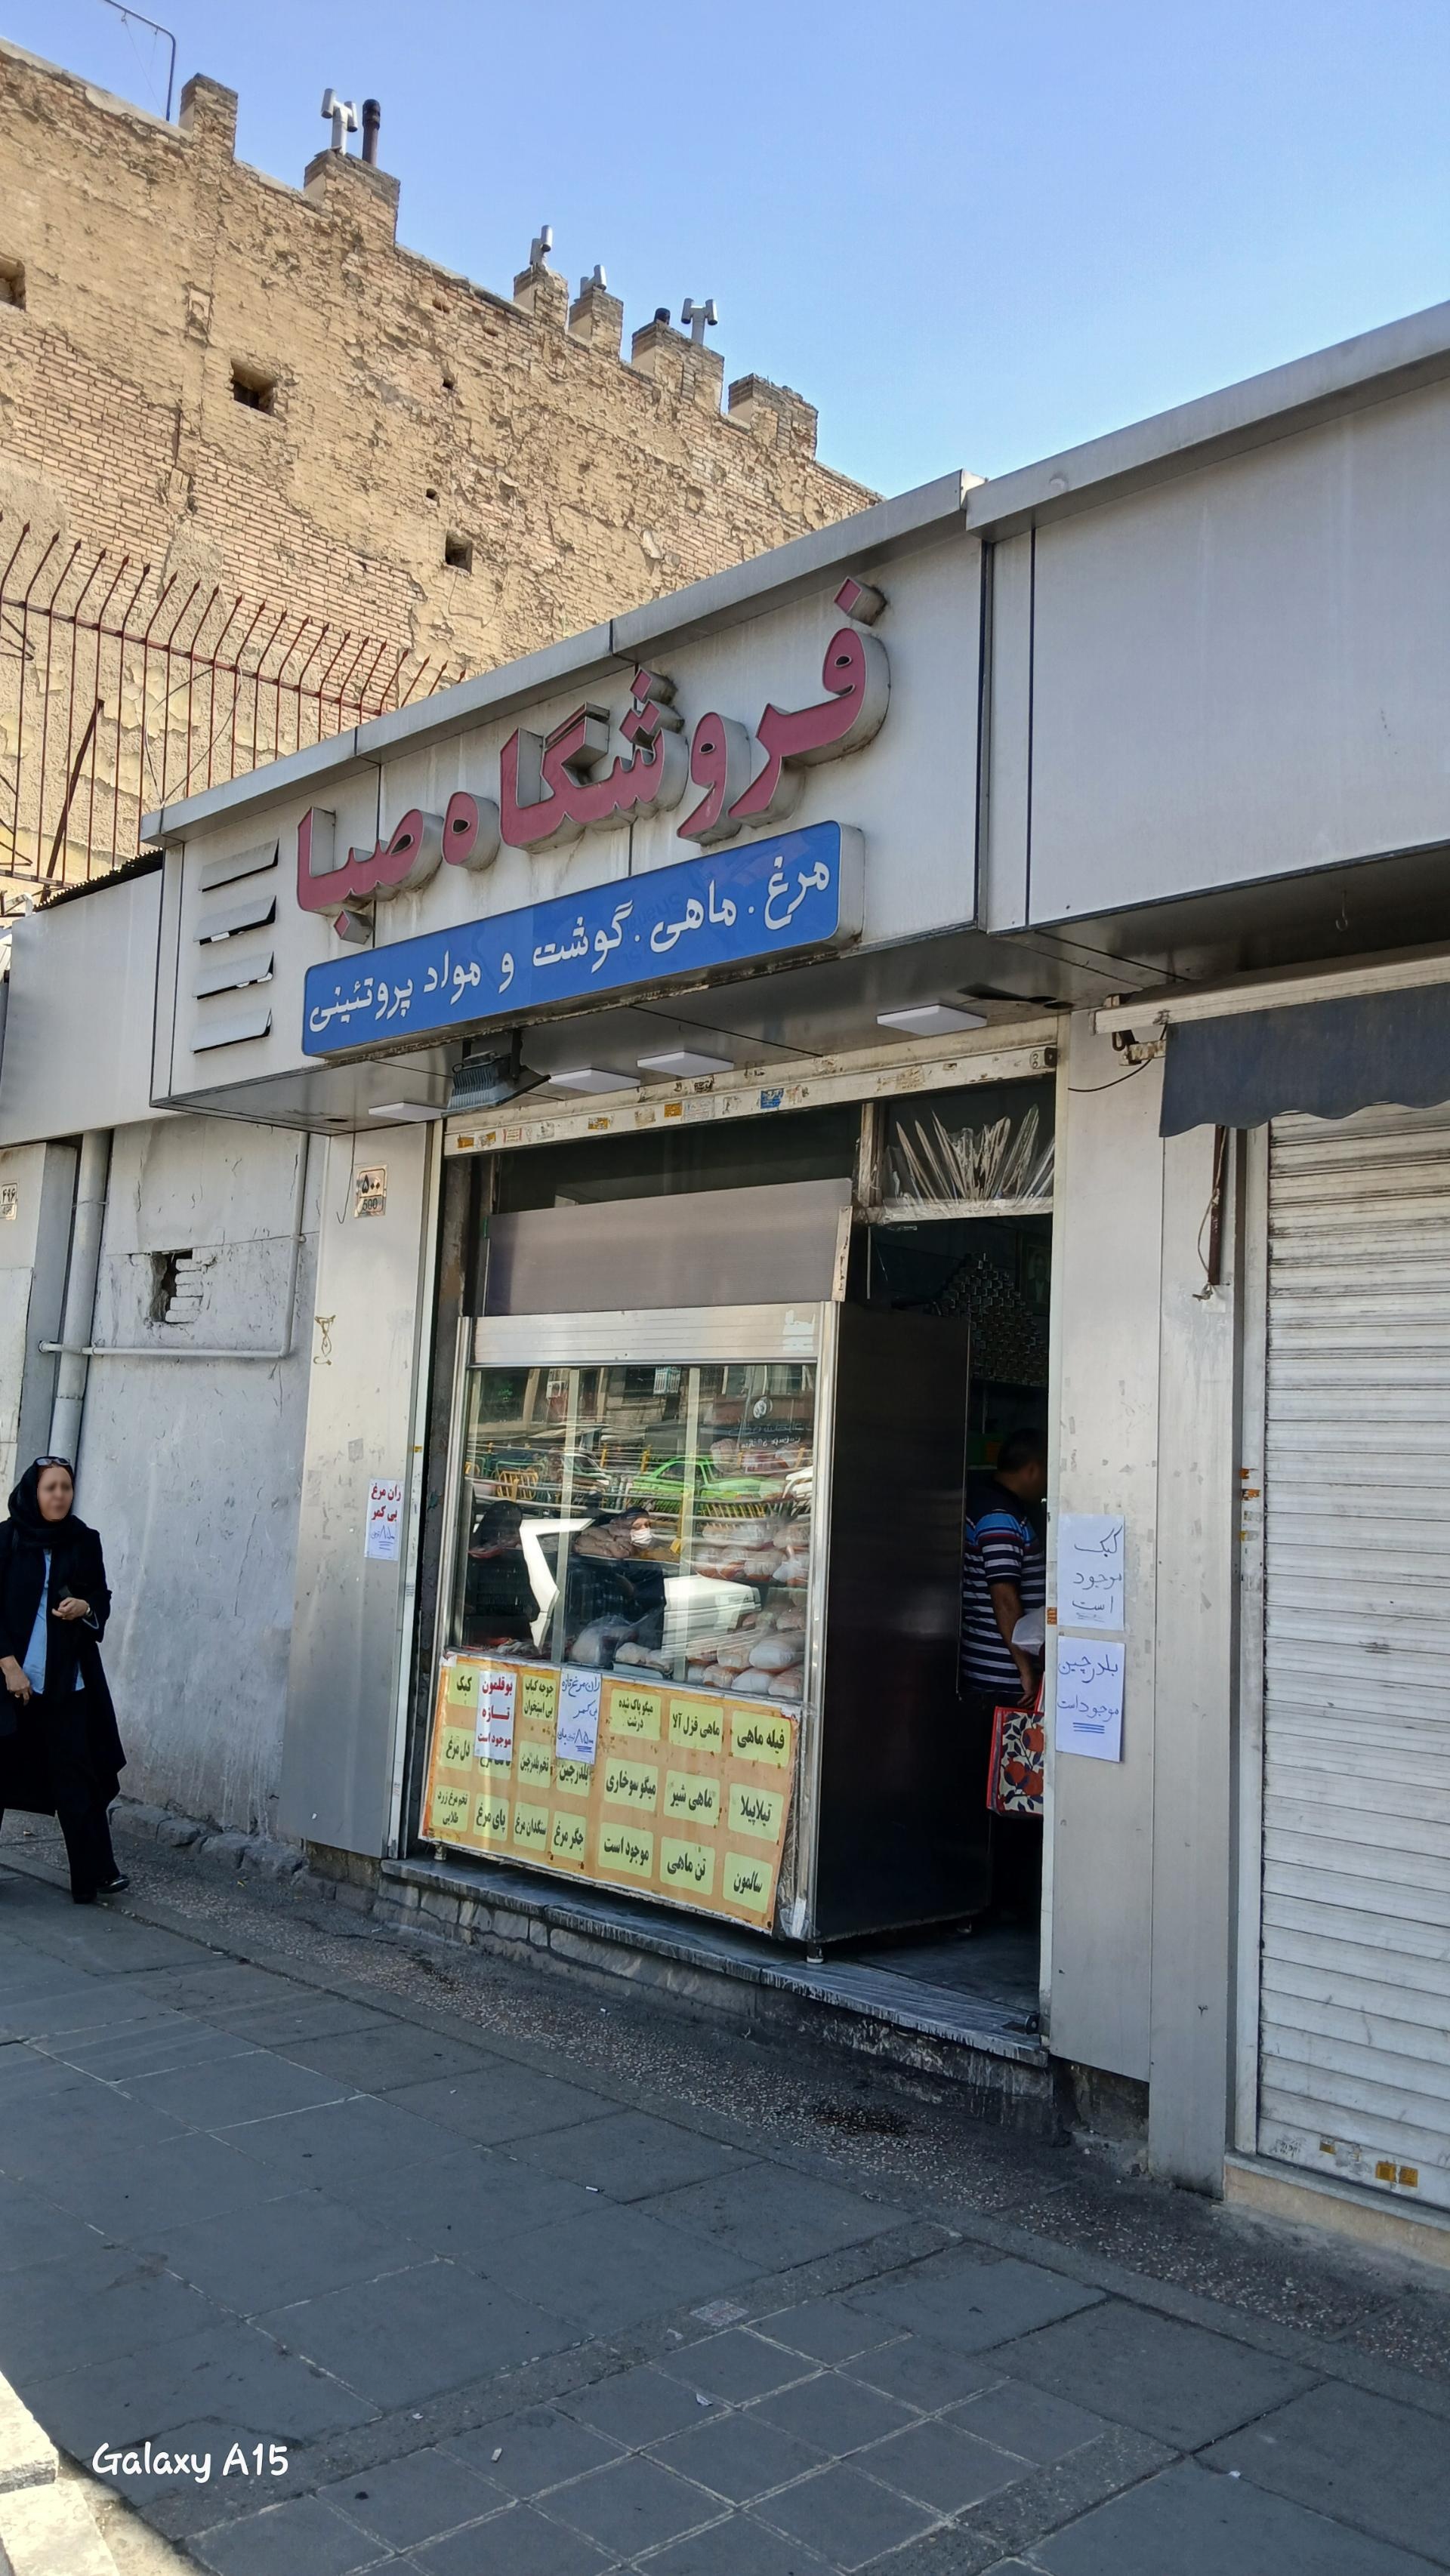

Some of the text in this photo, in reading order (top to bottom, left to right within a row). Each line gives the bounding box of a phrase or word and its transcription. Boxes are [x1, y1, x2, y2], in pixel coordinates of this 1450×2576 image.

[298, 577, 870, 938] فروشگاه صبا
[764, 855, 830, 930] مرغ
[650, 880, 737, 953] ماهی
[532, 899, 634, 974] گوشت
[423, 950, 482, 1005] مواد
[498, 952, 514, 994] و
[309, 977, 413, 1033] پروتئینی
[2, 1188, 16, 1203] ۴۹۶
[362, 1198, 378, 1211] 500
[372, 1483, 401, 1501] ران مرغ
[371, 1505, 397, 1522] بی کمر
[1074, 1525, 1123, 1558] کبک
[1072, 1572, 1122, 1590] موجود
[1072, 1595, 1114, 1613] است
[482, 1676, 513, 1696] بوقلمون
[525, 1678, 554, 1698] جوجه کباب
[585, 1676, 600, 1692] ران
[545, 1706, 553, 1719] بی
[572, 1699, 598, 1721] بی کمر
[618, 1697, 653, 1717] میگو پاک شده
[1057, 1694, 1119, 1722] موجود است
[627, 1715, 643, 1732] درشت
[672, 1712, 720, 1738] ماهی قزل آلا
[446, 1735, 470, 1761] دل مرغ
[478, 1732, 511, 1748] موجود است
[737, 1725, 785, 1755] فیله ماهی
[539, 1756, 550, 1774] تخم
[606, 1770, 656, 1800] میگو سوخاری
[670, 1784, 713, 1810] ماهی شیر
[437, 1789, 468, 1807] تخم مرغ زرد
[443, 1811, 459, 1825] طلایی
[476, 1802, 506, 1833] پای مرغ
[740, 1795, 773, 1827] تیلاپیلا
[514, 1813, 547, 1837] سنگدان مرغ
[554, 1820, 584, 1850] جگر مرغ
[603, 1836, 649, 1866] موجود است
[667, 1852, 707, 1881] تن ماهی
[733, 1870, 763, 1894] سالمون
